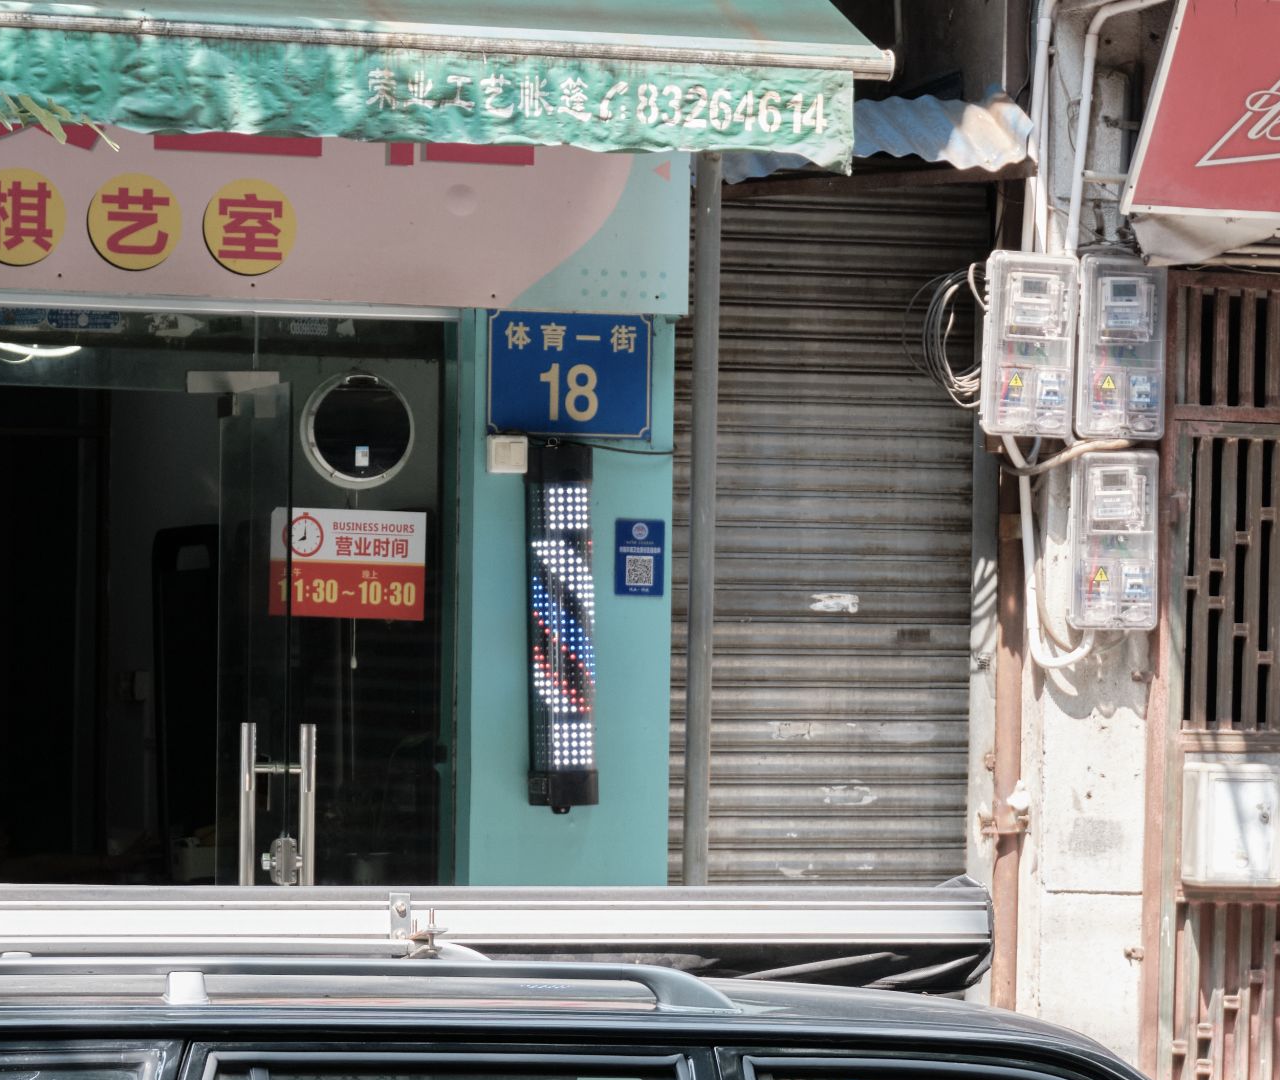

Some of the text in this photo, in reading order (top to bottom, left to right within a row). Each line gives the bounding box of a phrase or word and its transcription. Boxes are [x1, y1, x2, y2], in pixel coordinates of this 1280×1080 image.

[636, 83, 829, 135] 83264614
[504, 321, 638, 353] 体育一街
[539, 363, 599, 422] 18
[332, 521, 416, 534] BUSINESS HOURS
[335, 536, 410, 559] 营业时间
